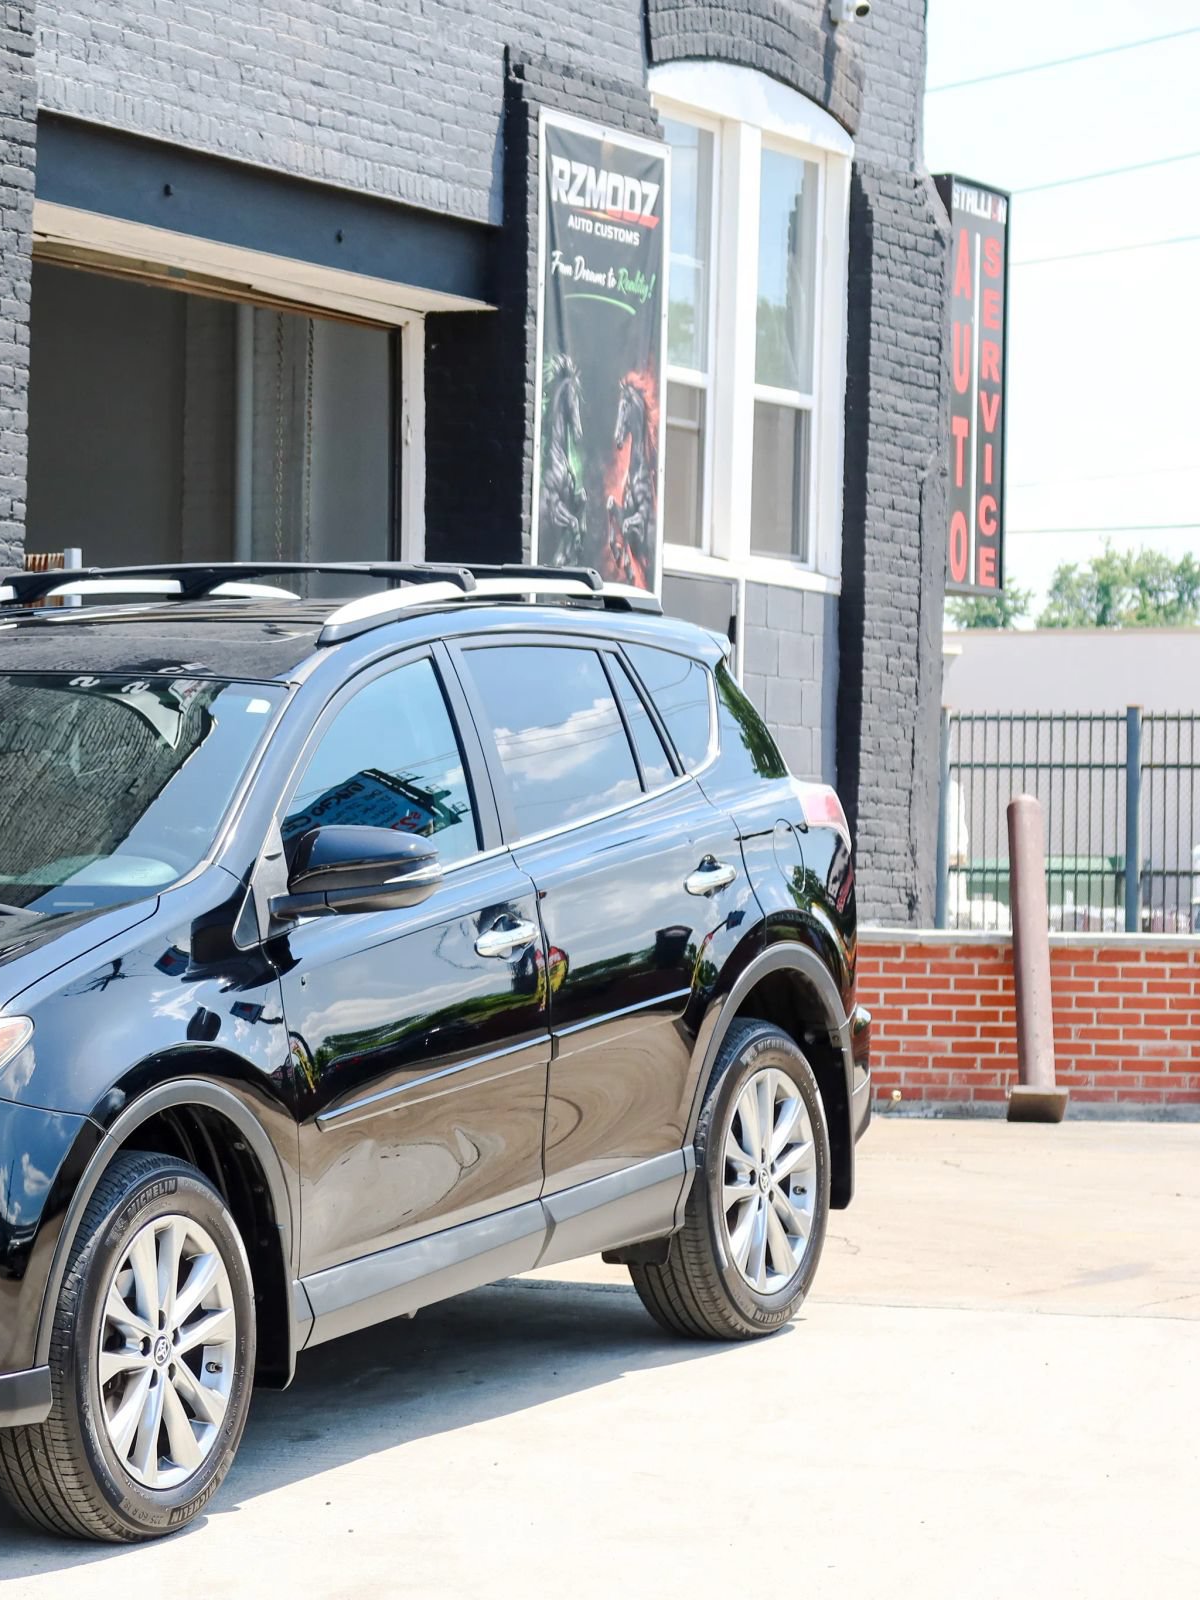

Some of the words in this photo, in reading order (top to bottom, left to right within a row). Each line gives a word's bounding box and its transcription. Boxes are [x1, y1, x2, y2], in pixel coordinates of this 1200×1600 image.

[551, 154, 660, 218] RZMODZ
[567, 214, 593, 234] AUTO
[594, 223, 641, 247] CUSTOMS
[607, 266, 618, 289] to
[950, 228, 972, 583] AUTO
[978, 237, 1001, 588] SERVICE
[127, 1179, 177, 1217] MICHELIN
